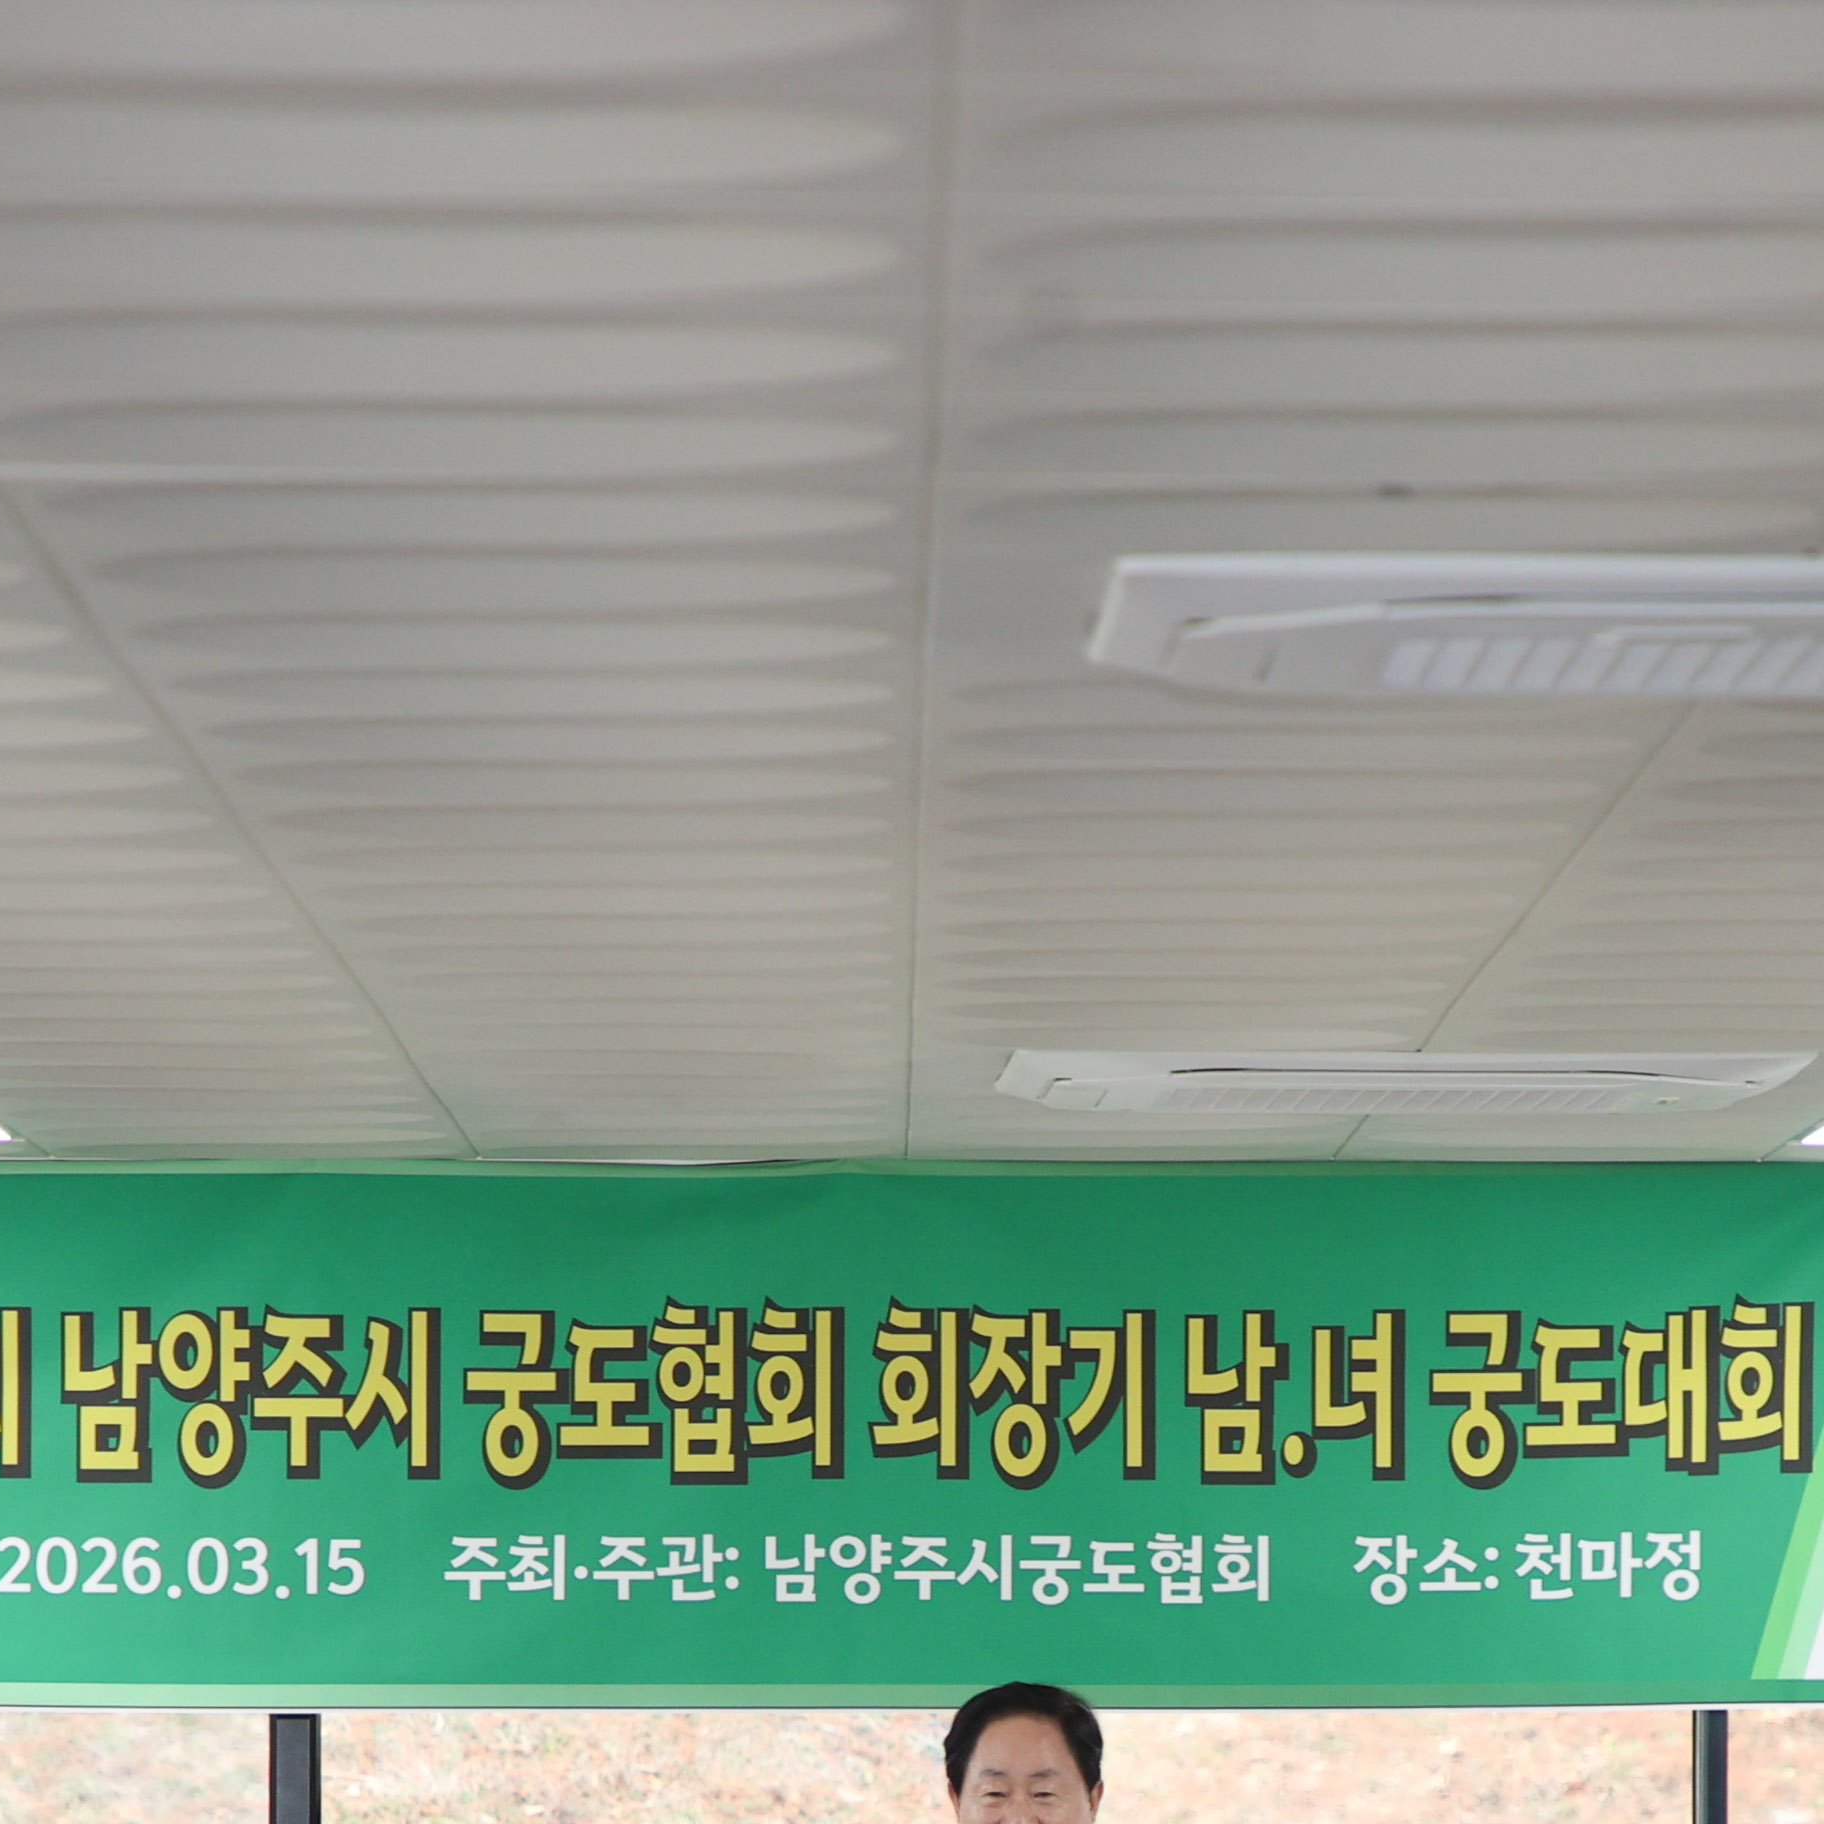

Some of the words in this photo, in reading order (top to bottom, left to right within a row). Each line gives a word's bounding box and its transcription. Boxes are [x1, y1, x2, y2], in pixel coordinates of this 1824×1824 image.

[62, 1305, 440, 1488] 남양주시
[463, 1297, 844, 1488] 궁도협회
[869, 1297, 1155, 1488] 회장기
[1429, 1297, 1814, 1488] 궁도대회
[763, 1531, 1271, 1606] 남양주시궁도협회
[1352, 1531, 1499, 1606] 장소:
[1514, 1530, 1703, 1602] 천마정
